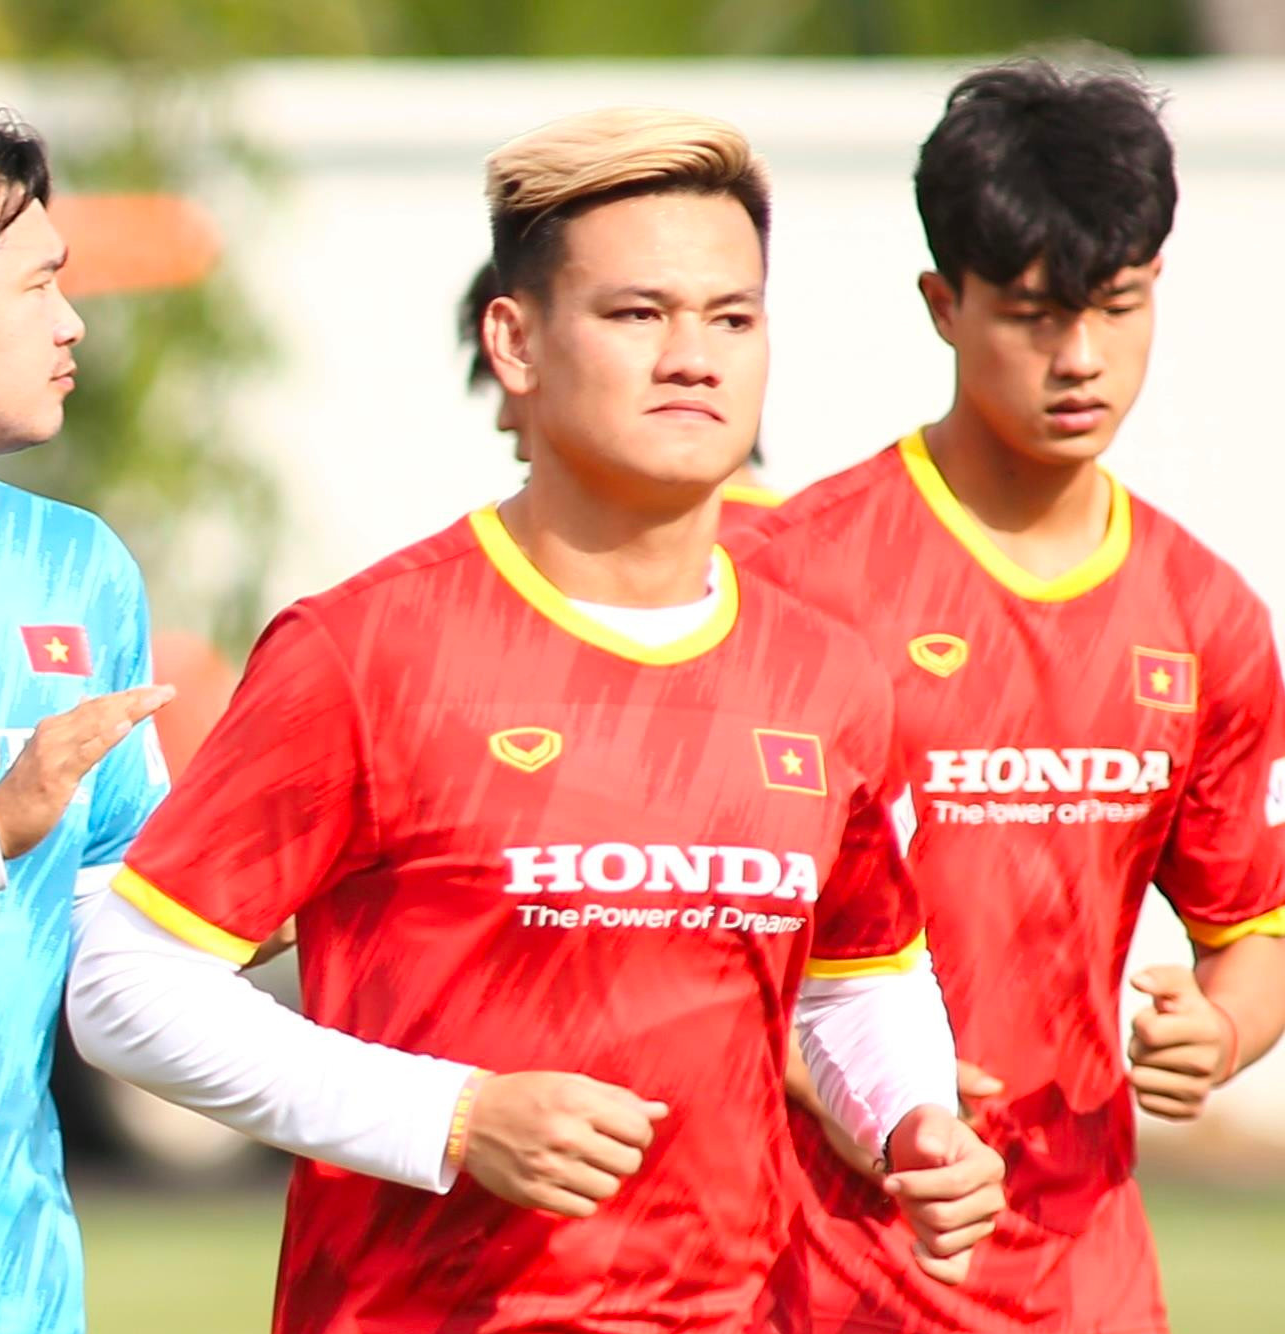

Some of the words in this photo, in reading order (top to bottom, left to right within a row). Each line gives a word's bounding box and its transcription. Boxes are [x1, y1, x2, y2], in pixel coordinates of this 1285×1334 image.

[923, 747, 1171, 794] HONDA
[932, 800, 986, 824] The
[1056, 799, 1088, 824] of
[502, 842, 819, 901] HONDA
[517, 905, 580, 928] The
[582, 905, 677, 929] Power
[681, 904, 716, 929] of
[719, 905, 806, 934] Dreams
